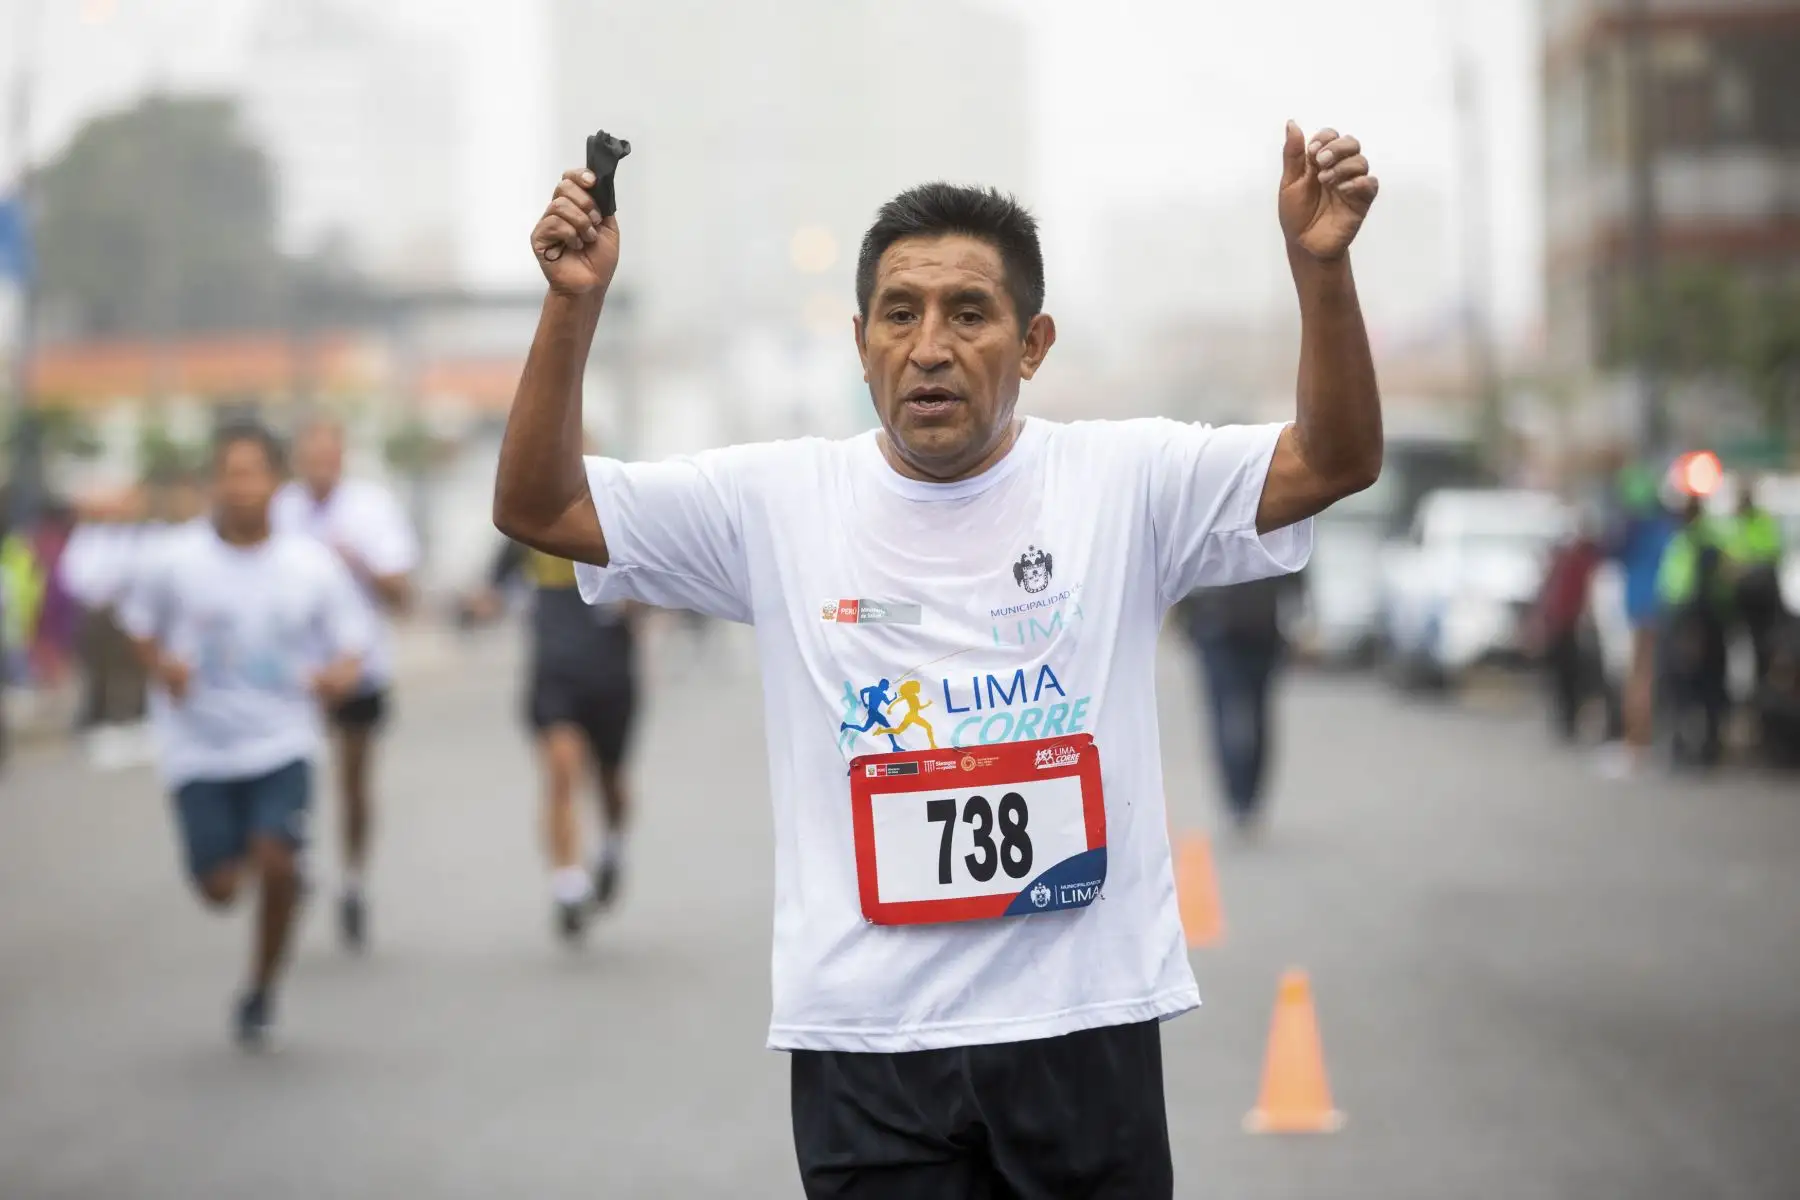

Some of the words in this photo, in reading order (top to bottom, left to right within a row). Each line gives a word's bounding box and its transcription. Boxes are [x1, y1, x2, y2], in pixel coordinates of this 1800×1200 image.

[990, 590, 1071, 619] MUNICIPALIDAD
[942, 664, 1066, 714] LIMA
[951, 695, 1091, 748] CORRE
[1054, 746, 1076, 756] LIMA
[1055, 752, 1080, 763] CORRE
[926, 792, 1033, 885] 738
[1061, 885, 1099, 904] LIMA
